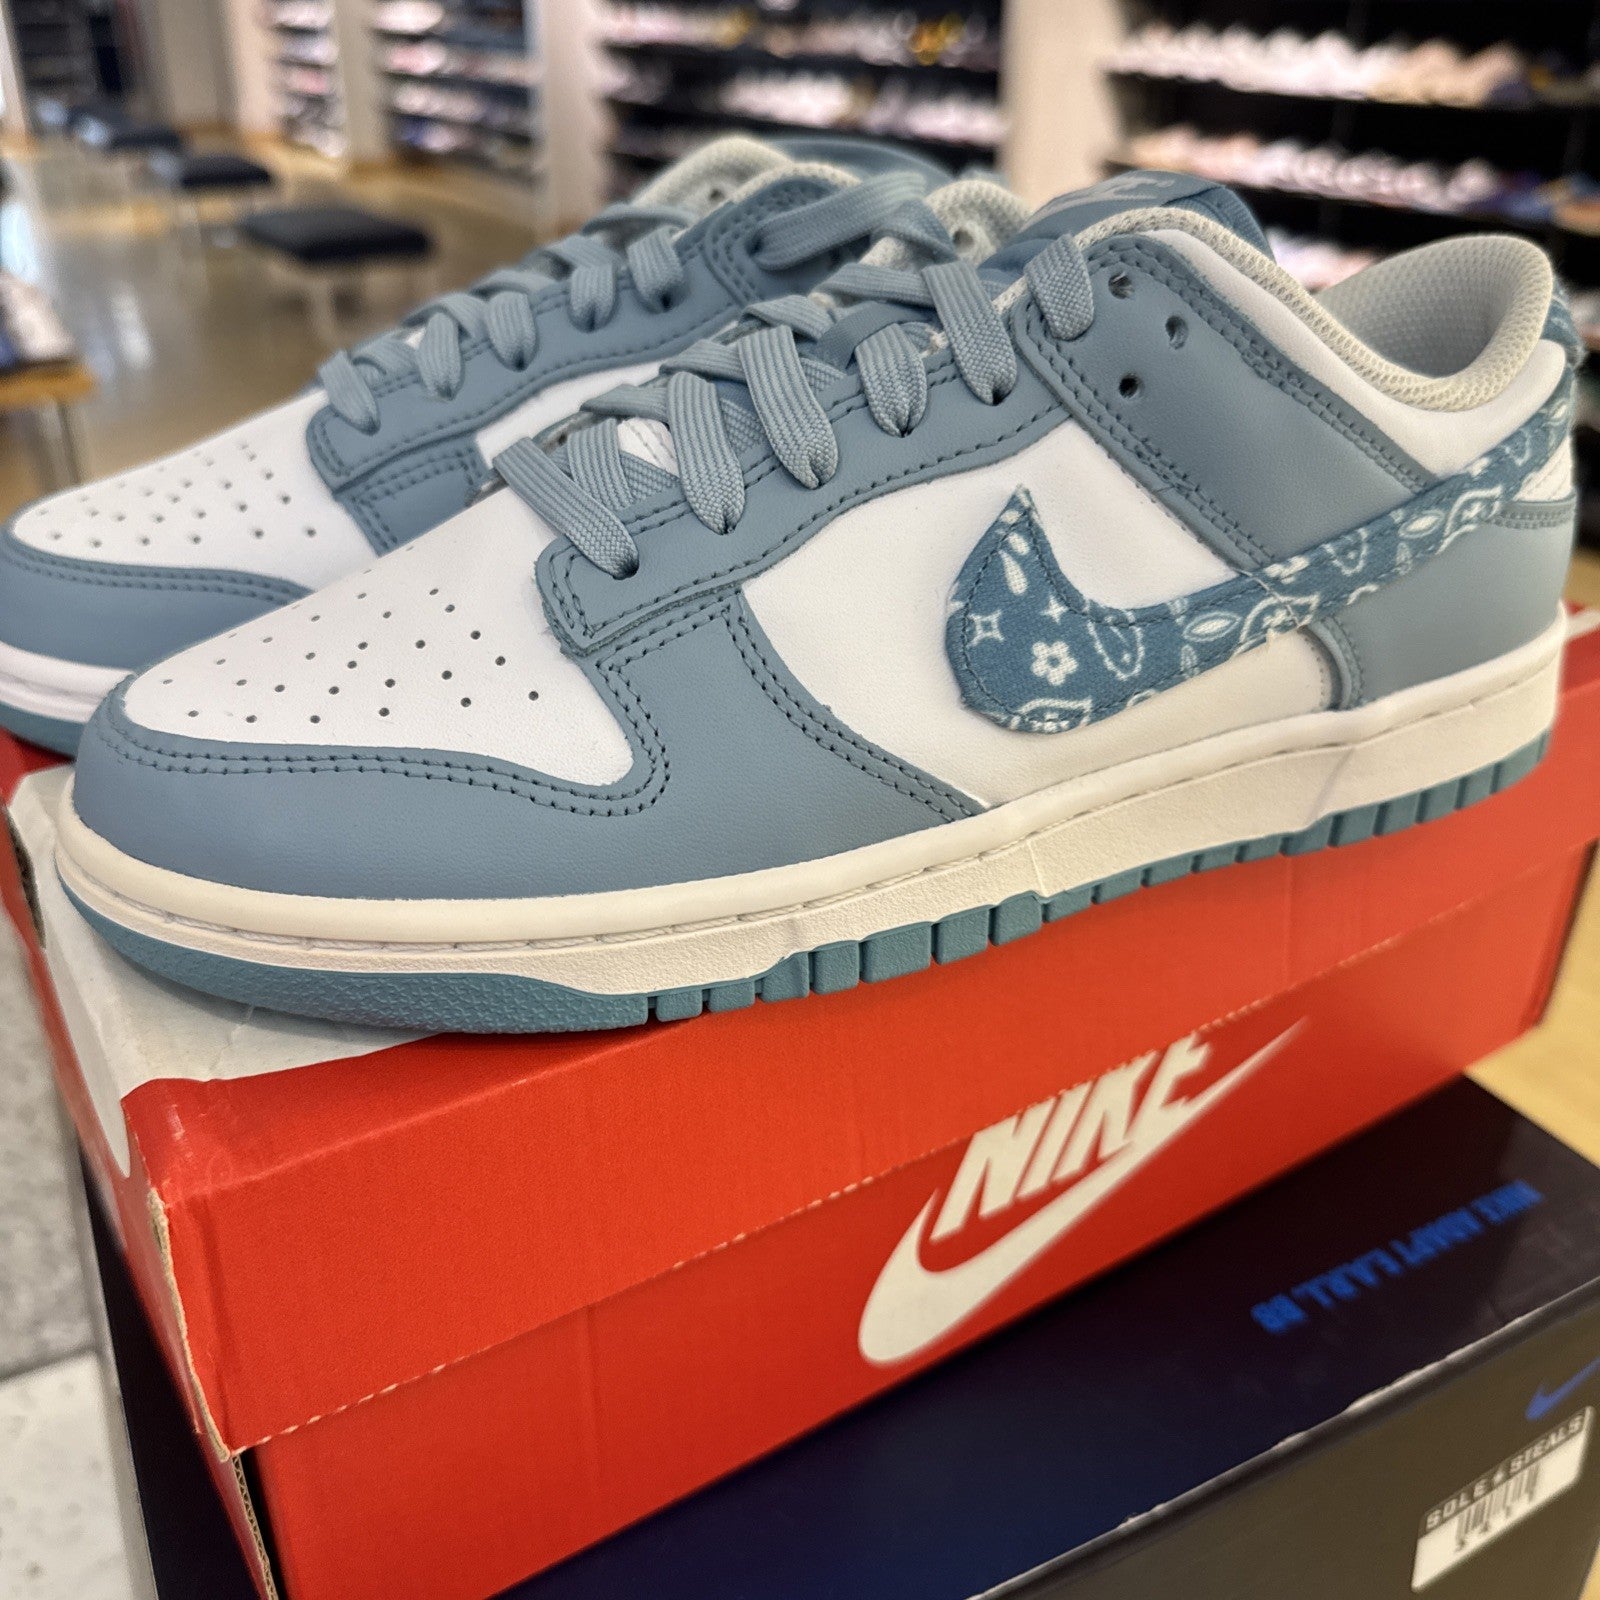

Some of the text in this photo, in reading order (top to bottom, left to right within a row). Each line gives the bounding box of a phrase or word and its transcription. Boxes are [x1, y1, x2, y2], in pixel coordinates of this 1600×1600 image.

[930, 1030, 1212, 1244] NIKE
[1426, 1478, 1490, 1531] SOLE
[1509, 1415, 1584, 1474] STEALS
